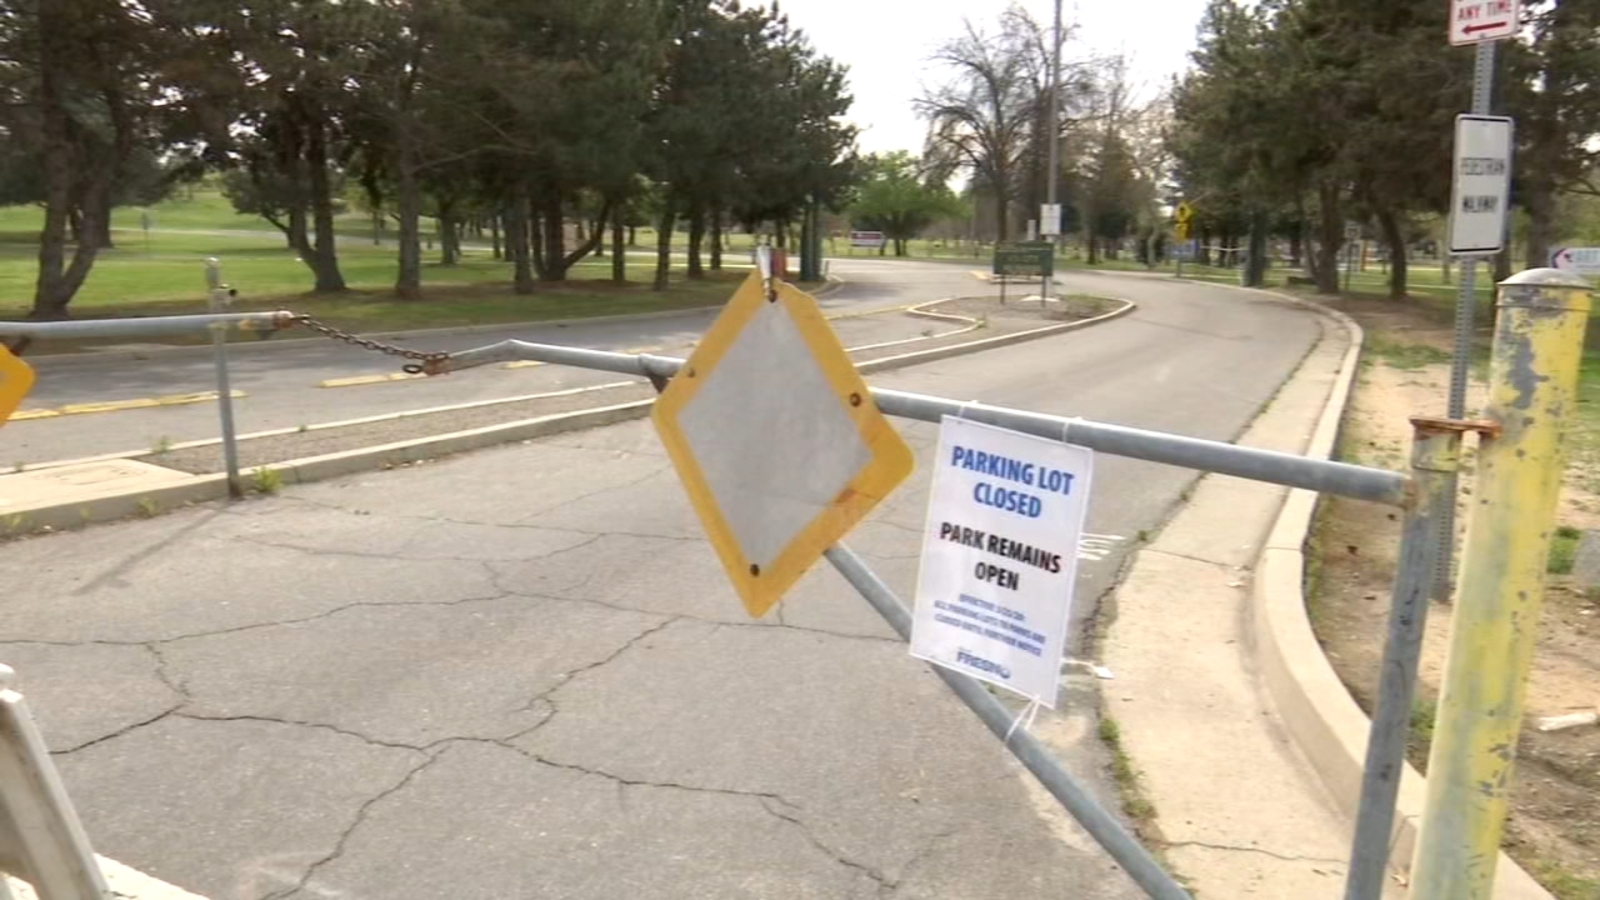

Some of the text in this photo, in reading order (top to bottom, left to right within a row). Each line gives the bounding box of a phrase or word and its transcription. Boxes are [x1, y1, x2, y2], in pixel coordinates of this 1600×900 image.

[1459, 0, 1511, 20] ANY TIME
[951, 445, 1074, 495] PARKING LOT
[973, 482, 1042, 518] CLOSED
[940, 522, 984, 549] PARK
[987, 534, 1061, 573] REMAINS
[975, 562, 1019, 590] OPEN
